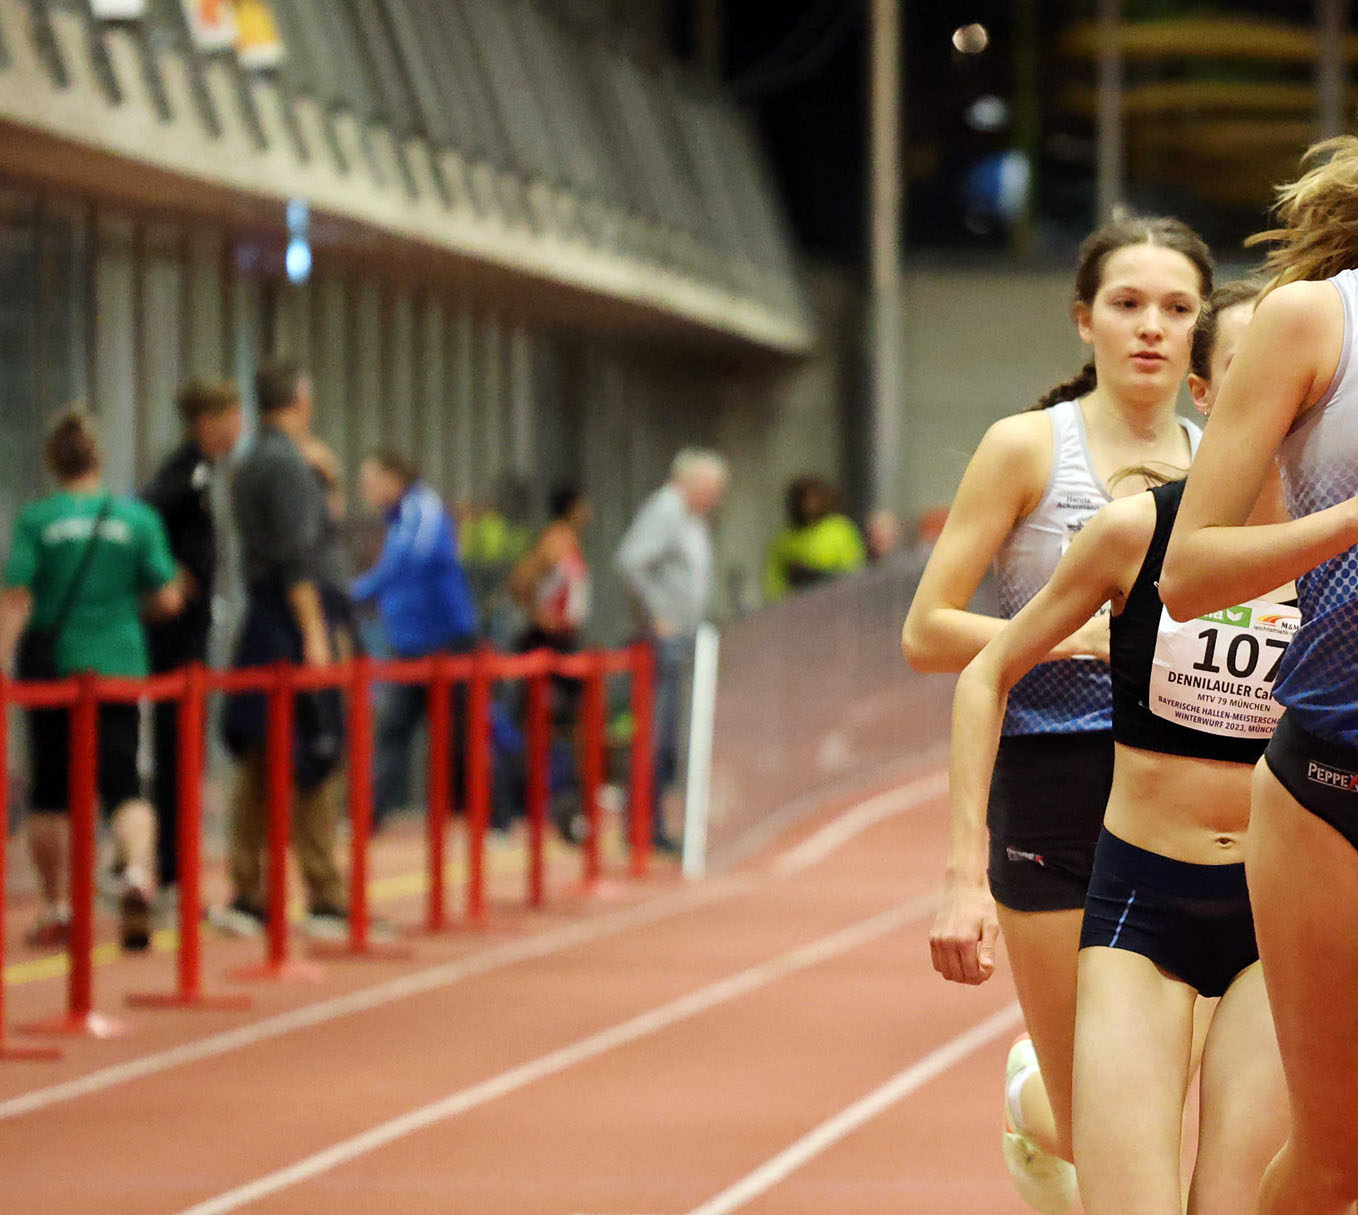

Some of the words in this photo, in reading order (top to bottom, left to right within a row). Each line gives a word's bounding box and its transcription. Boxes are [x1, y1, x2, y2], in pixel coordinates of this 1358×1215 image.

[1192, 628, 1290, 683] 107
[1167, 671, 1252, 697] DENNILAULER
[1158, 695, 1200, 713] BAYERISCHE
[1196, 693, 1216, 703] MTV
[1217, 696, 1228, 706] 79
[1229, 697, 1271, 712] MÜNCHEN
[1174, 710, 1224, 729] WINTERWURF
[1225, 721, 1247, 733] 2023,
